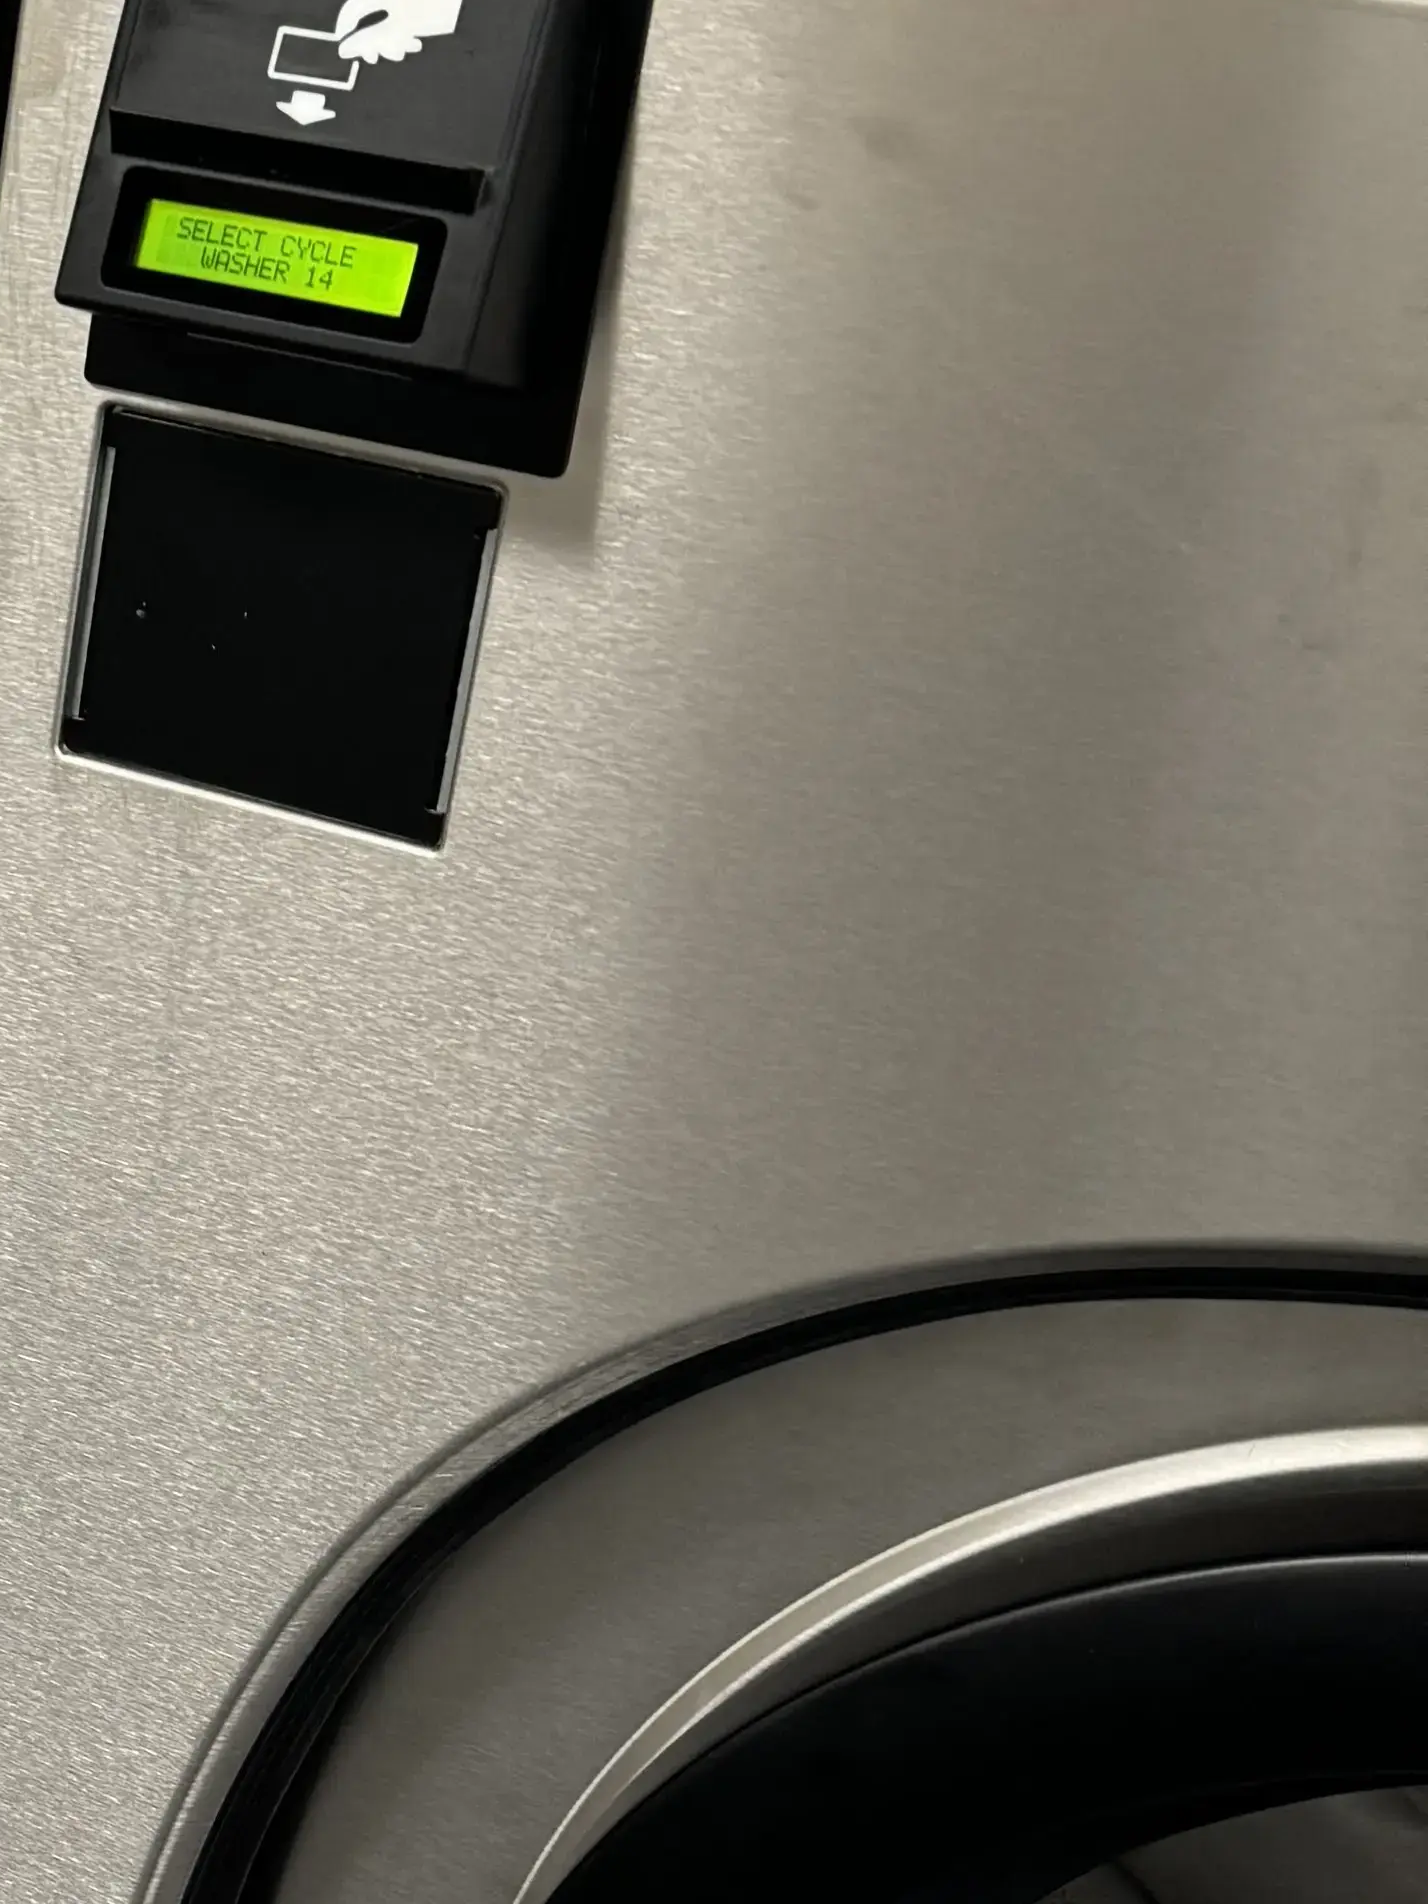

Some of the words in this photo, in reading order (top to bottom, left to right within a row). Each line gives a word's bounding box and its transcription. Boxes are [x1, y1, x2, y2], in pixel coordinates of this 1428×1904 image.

[176, 215, 269, 253] SELECT
[280, 234, 358, 270] CYCLE
[200, 246, 291, 284] WASHER
[303, 265, 334, 291] 14
